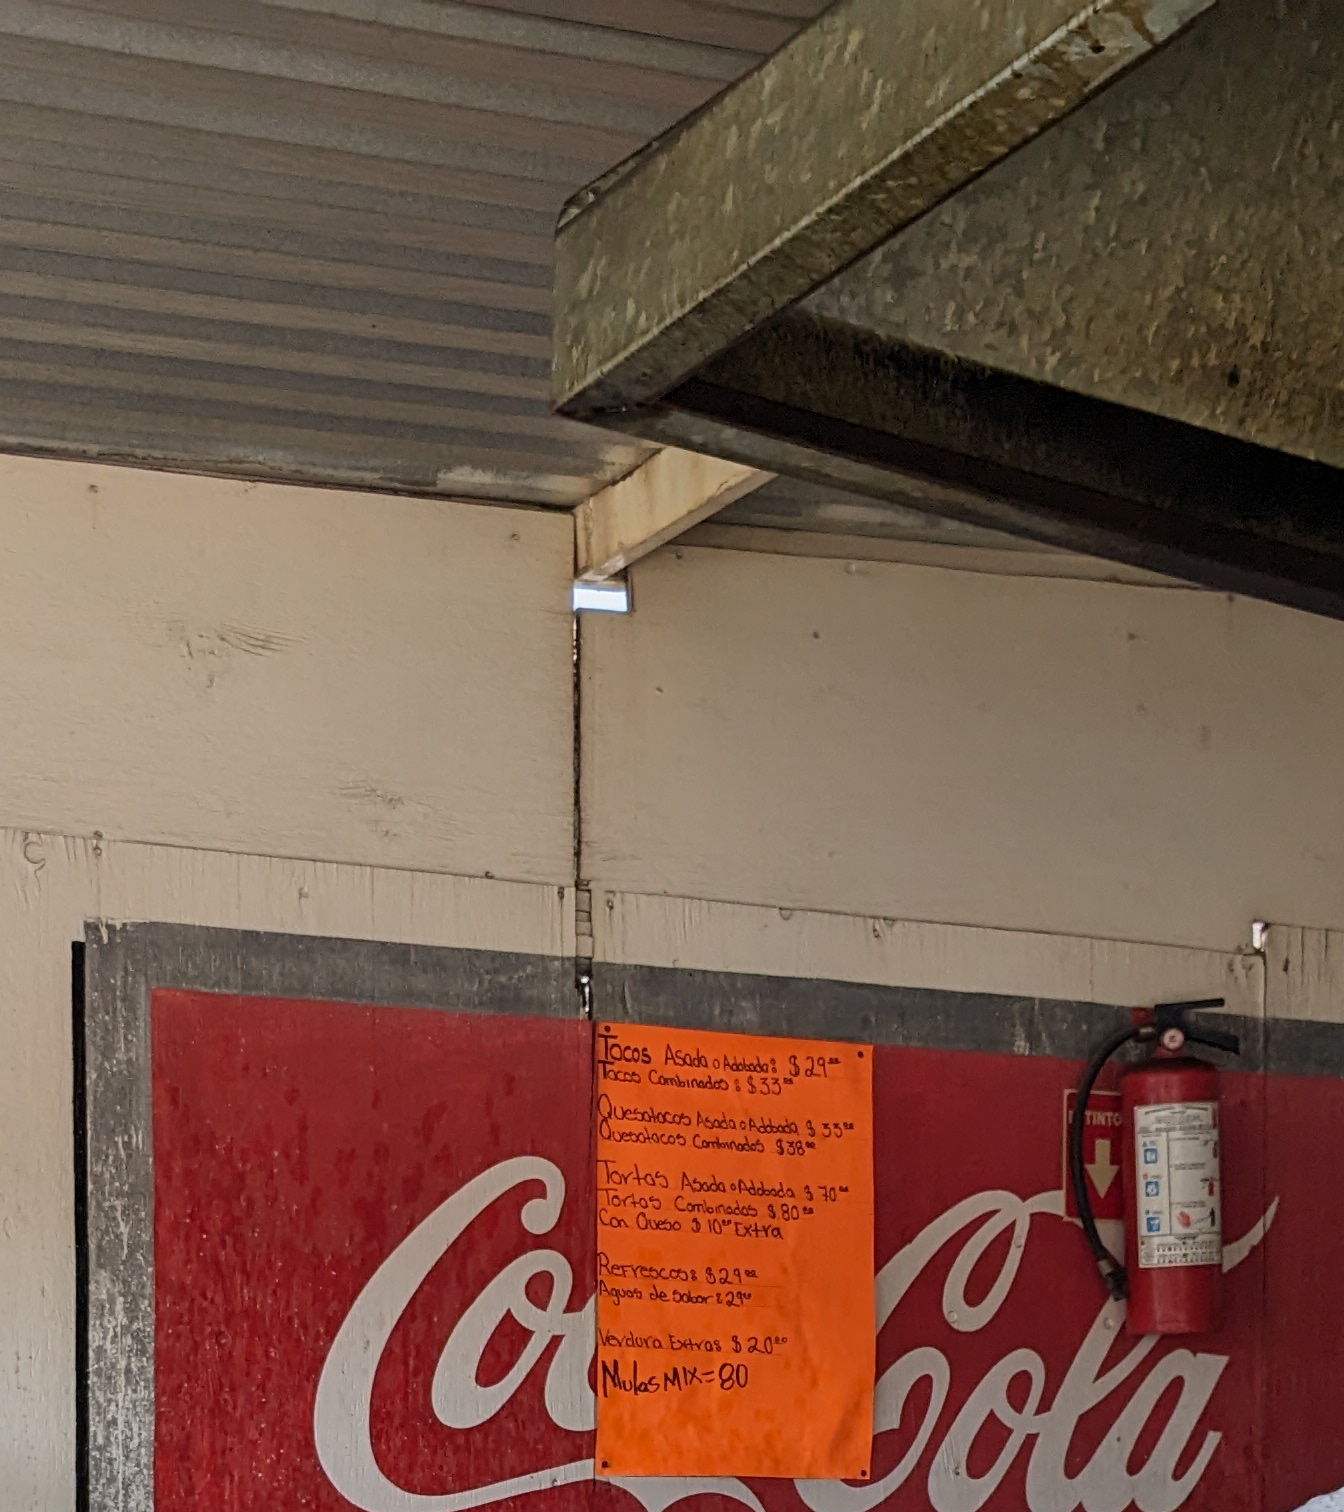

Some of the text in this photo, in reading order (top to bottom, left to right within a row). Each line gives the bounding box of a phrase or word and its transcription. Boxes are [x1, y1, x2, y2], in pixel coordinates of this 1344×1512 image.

[597, 1033, 652, 1065] Tacos
[664, 1043, 709, 1068] Asada
[597, 1060, 642, 1083] Tacos
[696, 1111, 737, 1130] Asada
[597, 1159, 668, 1189] Tortas
[681, 1171, 726, 1194] Asada
[597, 1188, 662, 1211] Tortas
[599, 1208, 629, 1228] Con
[636, 1212, 682, 1233] Queso
[734, 1221, 784, 1241] Extra
[599, 1280, 643, 1306] Aguas
[649, 1284, 670, 1302] de
[598, 1328, 663, 1349] Verdura
